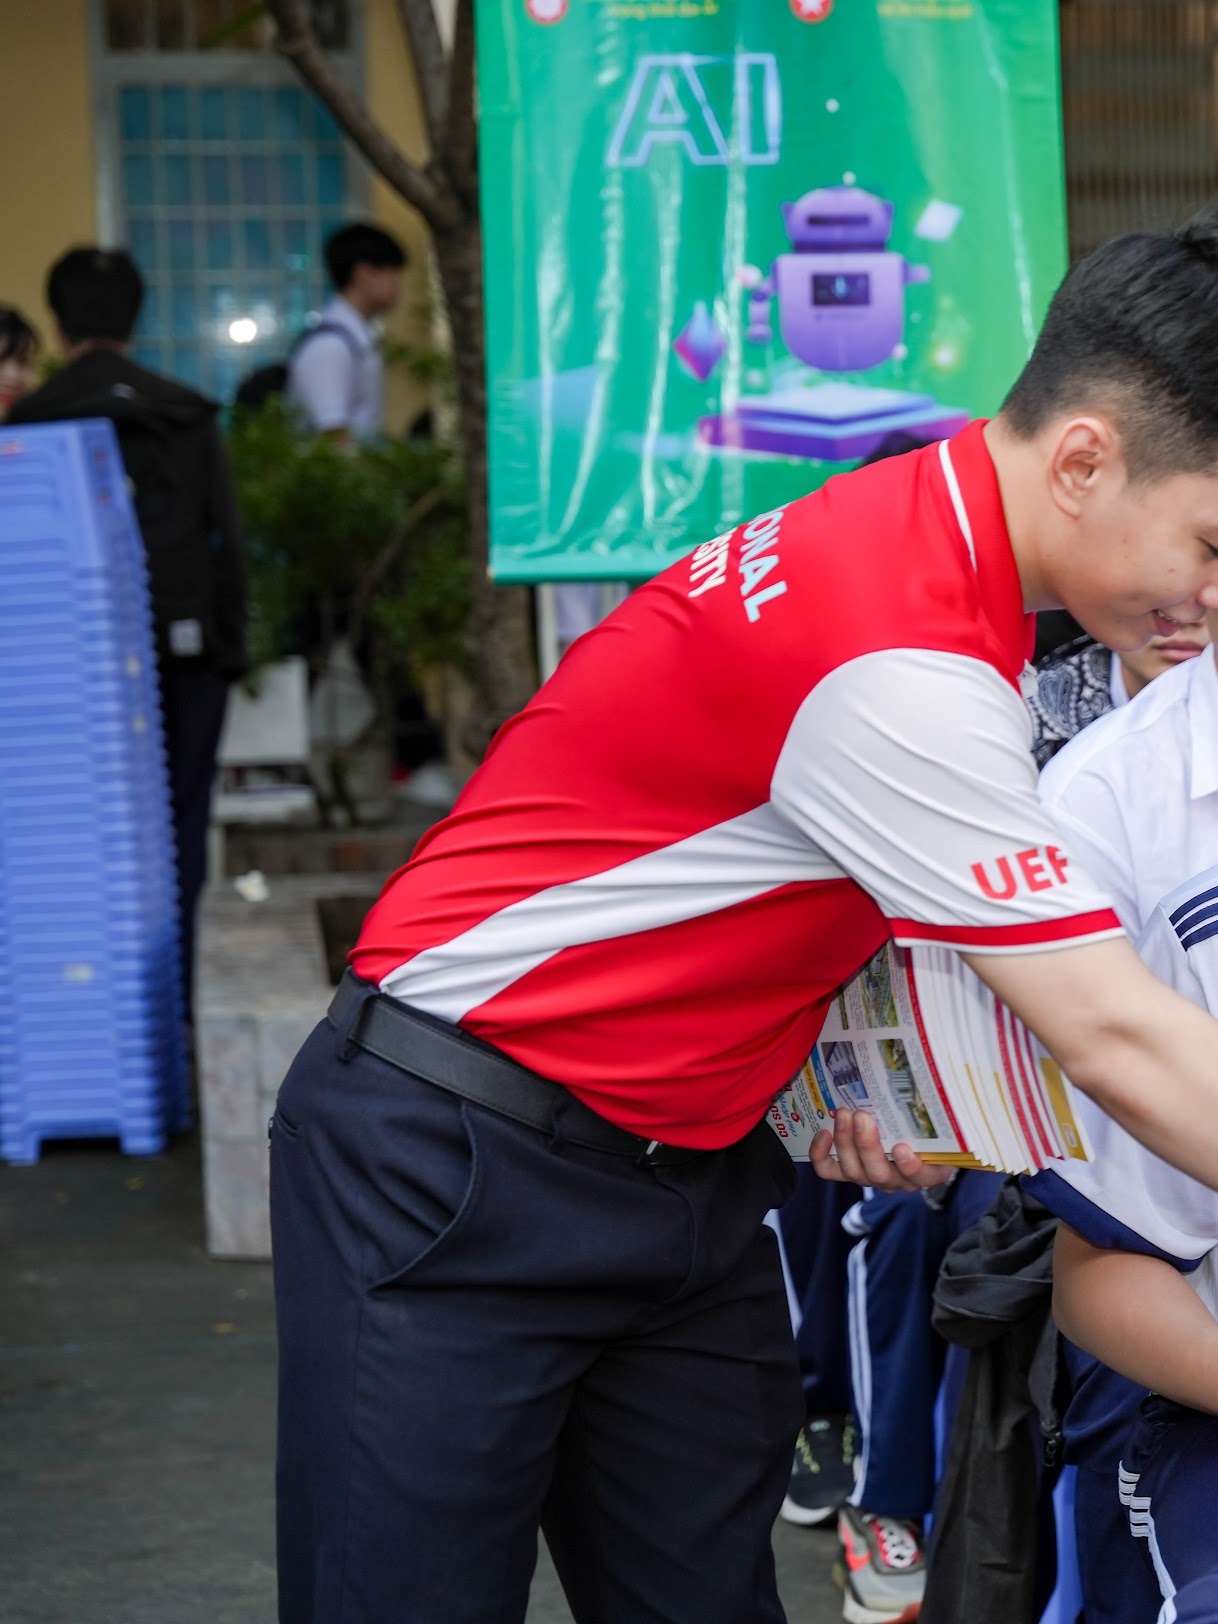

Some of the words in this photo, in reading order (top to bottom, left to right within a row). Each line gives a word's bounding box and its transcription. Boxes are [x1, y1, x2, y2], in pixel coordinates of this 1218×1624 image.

[605, 52, 781, 167] AI
[688, 530, 734, 598] SITY
[739, 510, 788, 623] ONAL
[970, 844, 1068, 900] UEF
